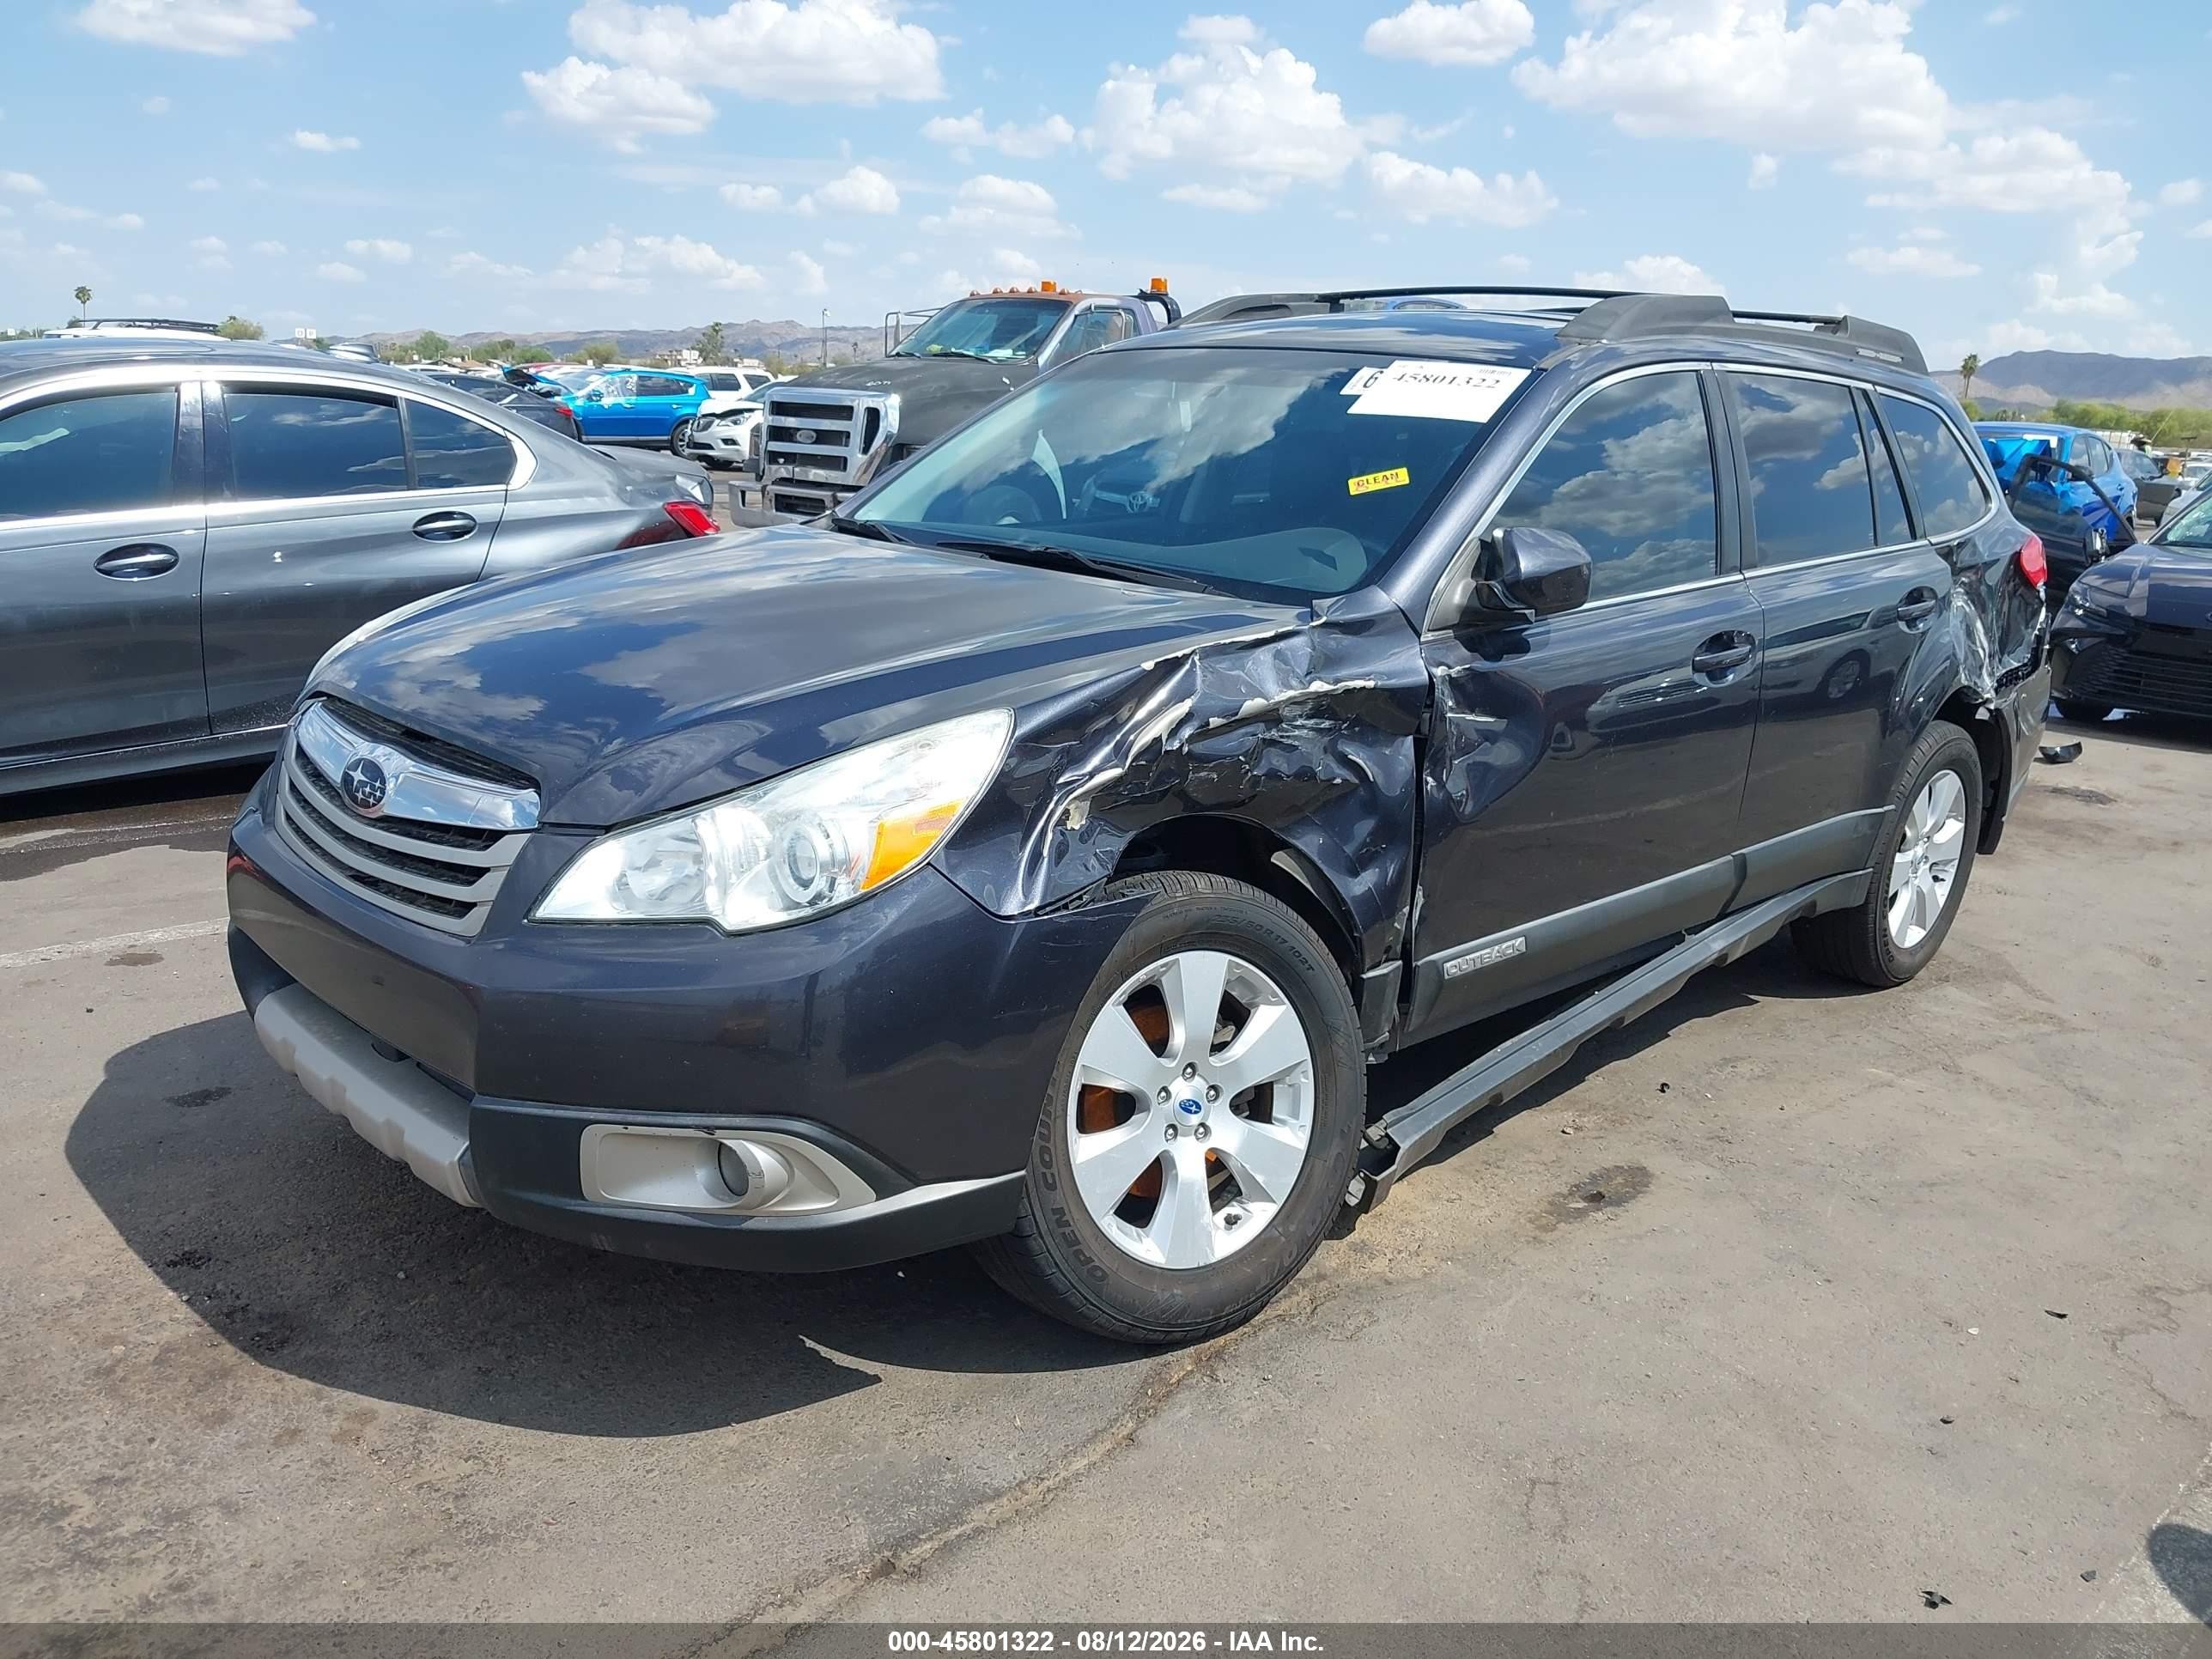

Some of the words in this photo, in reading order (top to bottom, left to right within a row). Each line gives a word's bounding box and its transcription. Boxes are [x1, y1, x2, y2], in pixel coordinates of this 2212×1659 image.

[1363, 370, 1384, 389] 6
[1393, 373, 1501, 389] 45801322
[1356, 471, 1400, 488] CLEAN
[1445, 939, 1524, 976] OUTBACK
[1050, 1206, 1109, 1283] OPEN
